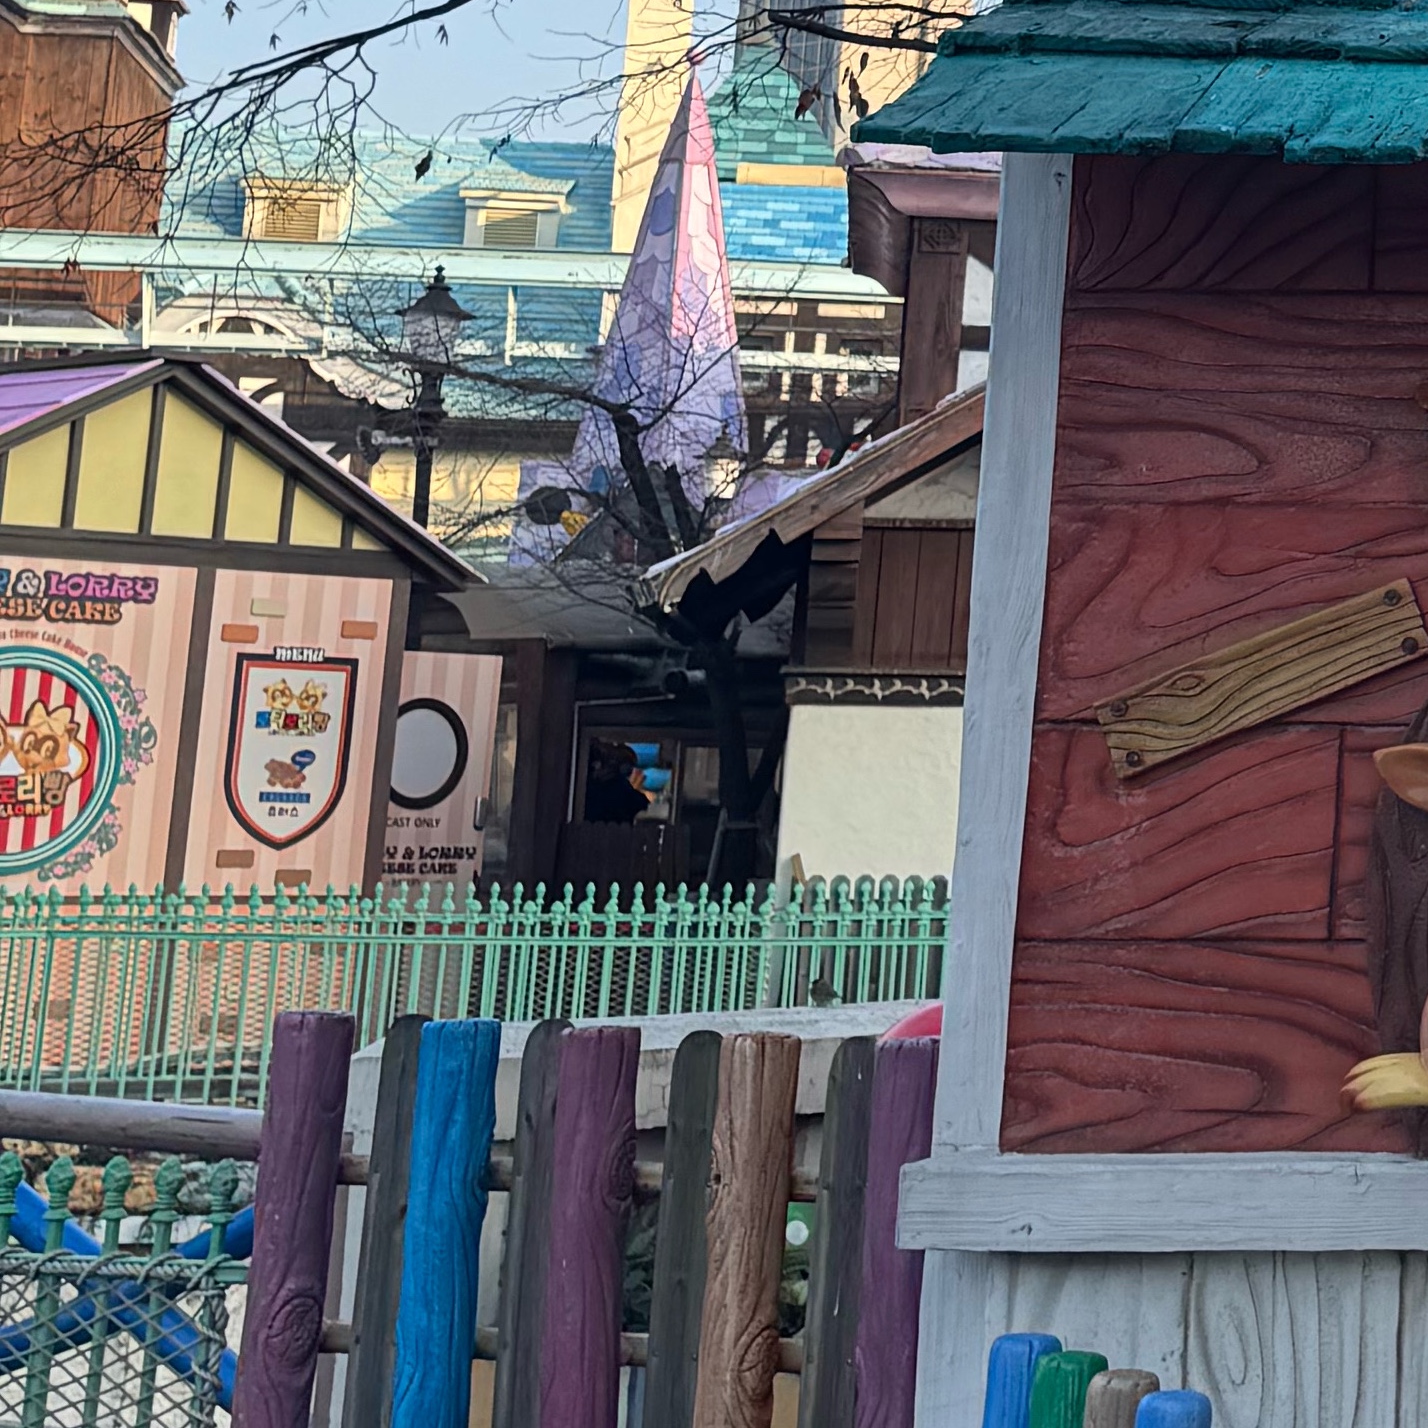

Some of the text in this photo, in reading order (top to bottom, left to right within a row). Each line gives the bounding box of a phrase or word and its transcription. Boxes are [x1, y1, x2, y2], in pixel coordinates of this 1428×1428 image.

[14, 570, 40, 597] &
[48, 572, 157, 602] LORRY
[49, 600, 121, 622] CAKE
[414, 817, 441, 828] ONLY
[402, 846, 415, 860] &
[418, 846, 477, 860] LORRY
[419, 863, 458, 875] CAKE
